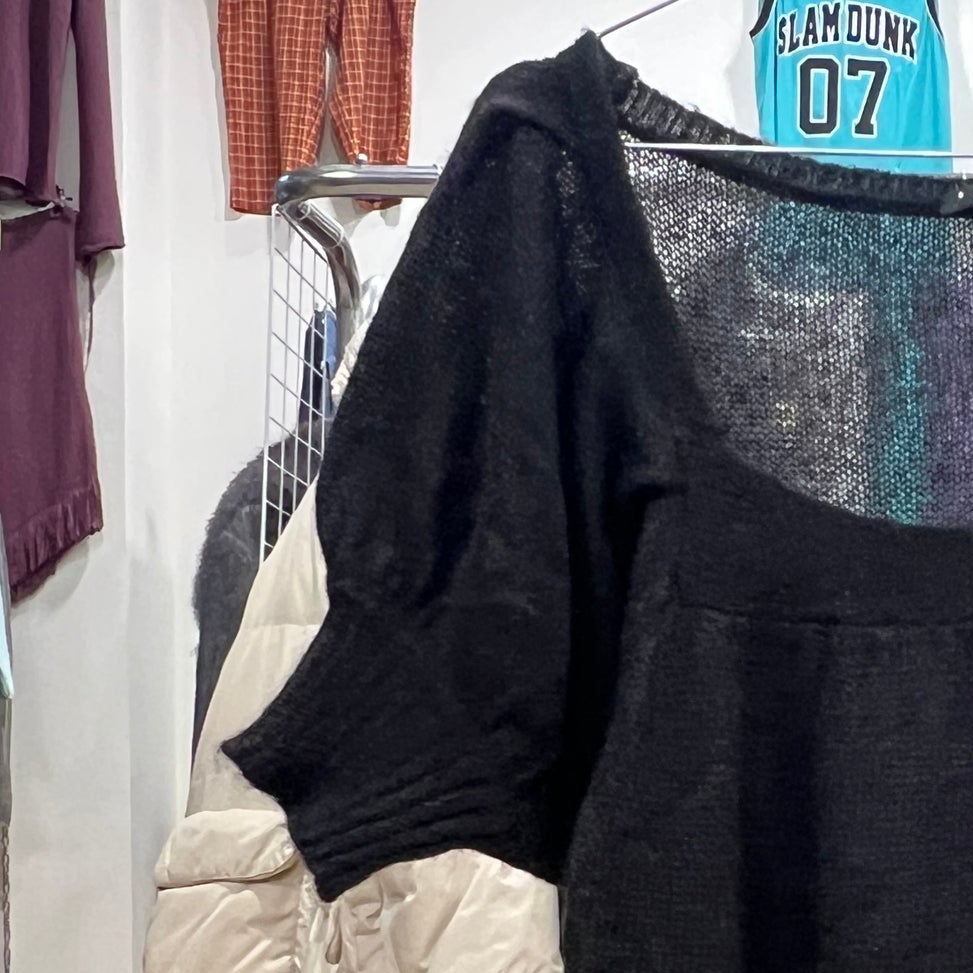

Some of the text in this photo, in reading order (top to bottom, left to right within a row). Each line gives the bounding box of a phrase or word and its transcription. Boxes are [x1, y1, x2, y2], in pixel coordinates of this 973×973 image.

[777, 2, 918, 61] SLAM DUNK
[799, 57, 888, 136] 07
